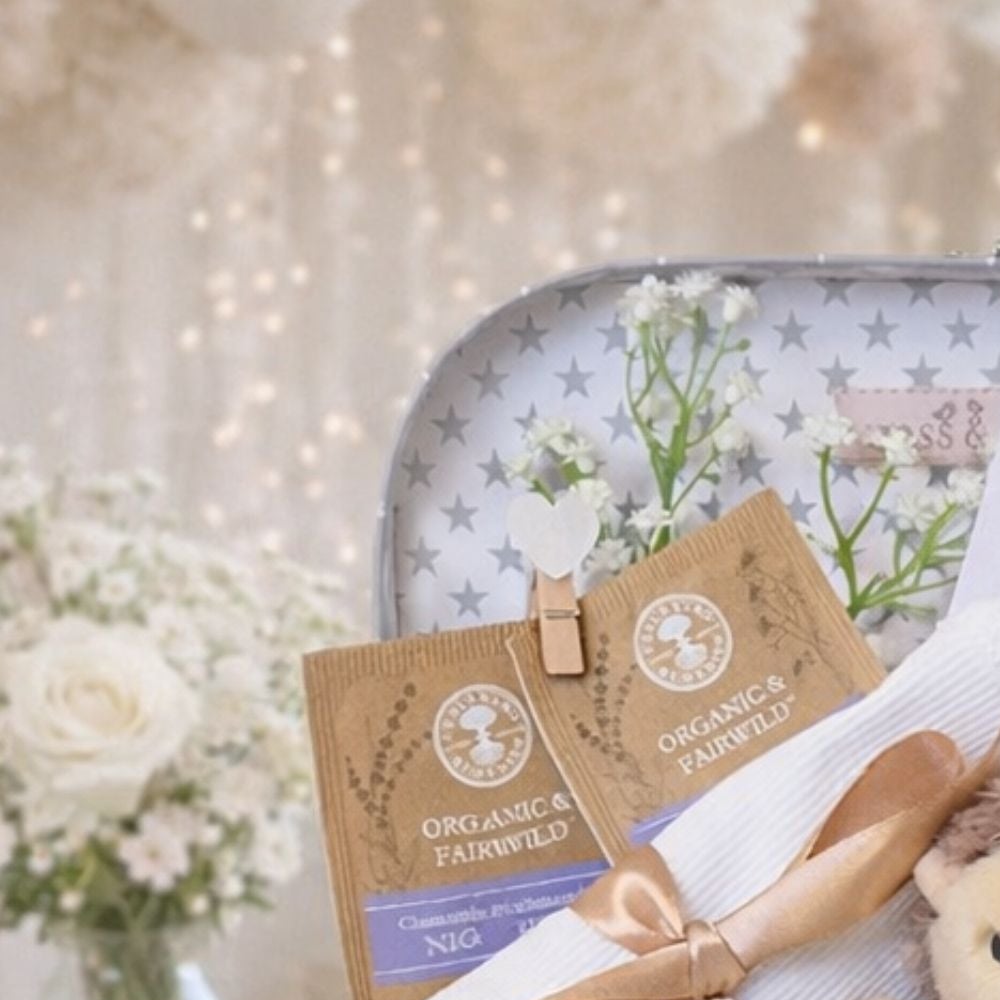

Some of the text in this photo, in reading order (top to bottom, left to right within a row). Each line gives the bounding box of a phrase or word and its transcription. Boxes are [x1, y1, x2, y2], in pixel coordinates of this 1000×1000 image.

[658, 675, 787, 754] ORGANIC &
[677, 700, 791, 775] FAIRWILD
[421, 796, 548, 840] ORGANIC
[433, 820, 569, 868] FAIRWILD
